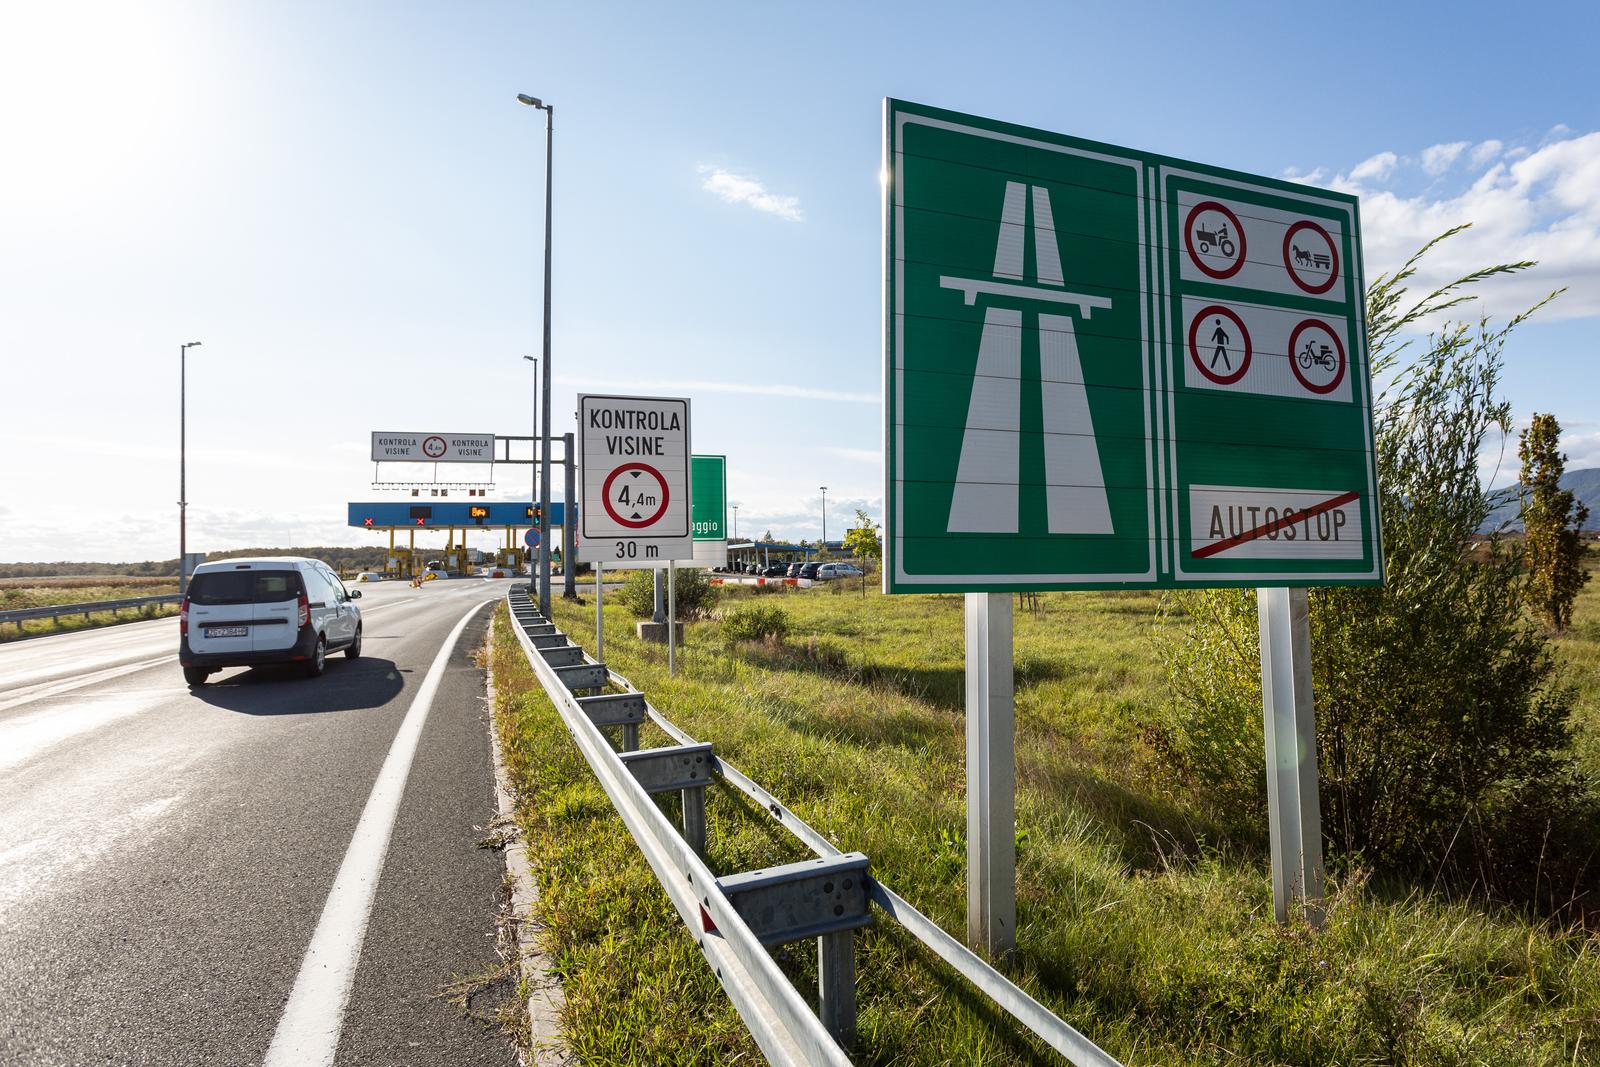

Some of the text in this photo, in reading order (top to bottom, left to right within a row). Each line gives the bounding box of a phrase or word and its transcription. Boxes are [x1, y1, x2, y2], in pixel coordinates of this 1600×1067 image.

[590, 408, 681, 431] KONTROLA
[378, 438, 417, 446] KONTROLA
[385, 447, 411, 455] VISINE
[452, 439, 489, 447] KONTROLA
[606, 435, 665, 456] VISINE
[458, 448, 483, 456] VISINE
[618, 485, 656, 508] 4,4m
[1209, 505, 1346, 541] AUTOSTOP
[616, 541, 659, 559] 30 m
